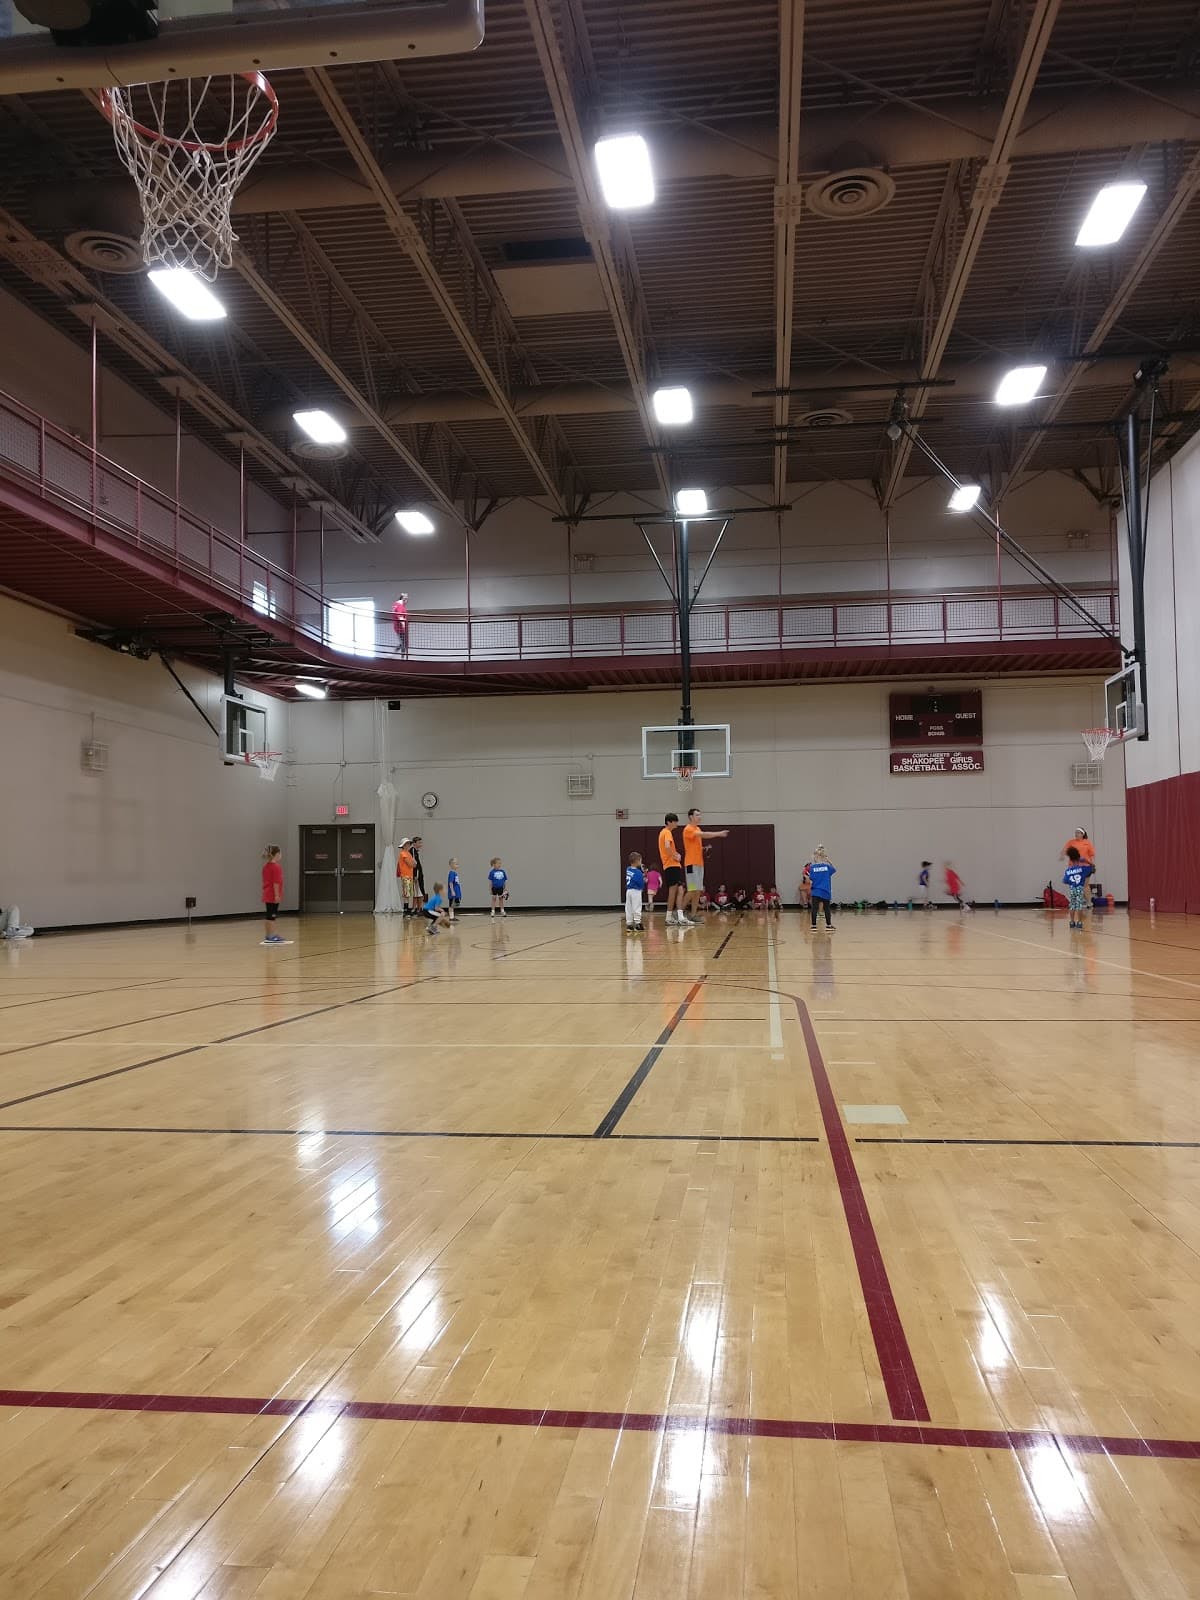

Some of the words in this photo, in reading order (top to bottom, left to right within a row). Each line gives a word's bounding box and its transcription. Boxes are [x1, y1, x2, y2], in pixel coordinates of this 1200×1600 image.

[901, 757, 945, 766] SHAKOPEE
[893, 764, 947, 772] BASKETBALL
[951, 762, 983, 771] ASSOC.
